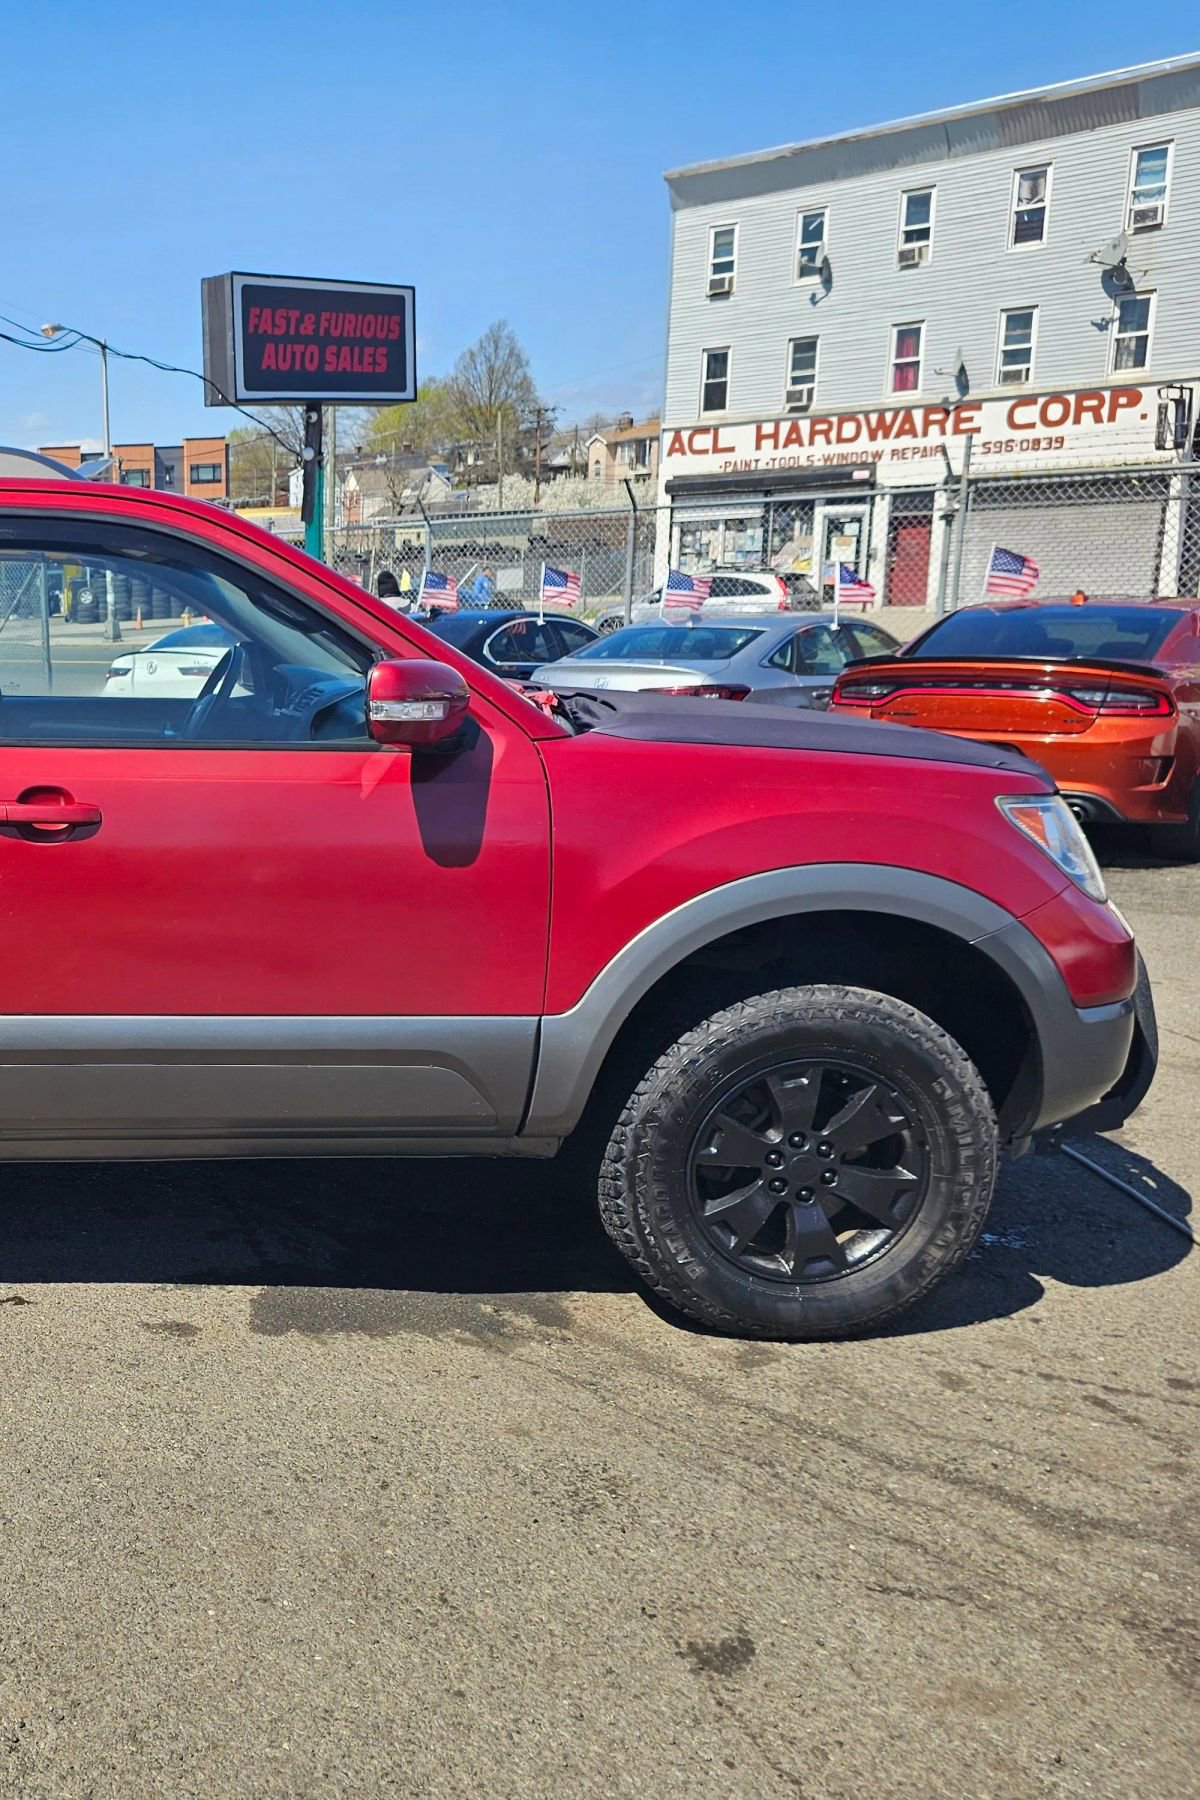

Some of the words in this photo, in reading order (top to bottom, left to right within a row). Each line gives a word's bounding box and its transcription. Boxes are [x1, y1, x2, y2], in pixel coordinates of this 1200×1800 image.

[248, 306, 300, 336] FAST
[299, 312, 317, 336] &
[318, 311, 401, 340] FURIOUS
[261, 342, 319, 372] AUTO
[323, 346, 389, 373] SALES
[667, 427, 736, 457] ACL
[755, 403, 983, 450] HARDWARE
[1006, 387, 1148, 431] CORP.
[822, 449, 885, 465] WINDOW
[890, 444, 945, 462] REPAIR
[651, 1142, 705, 1280] PATAGONI
